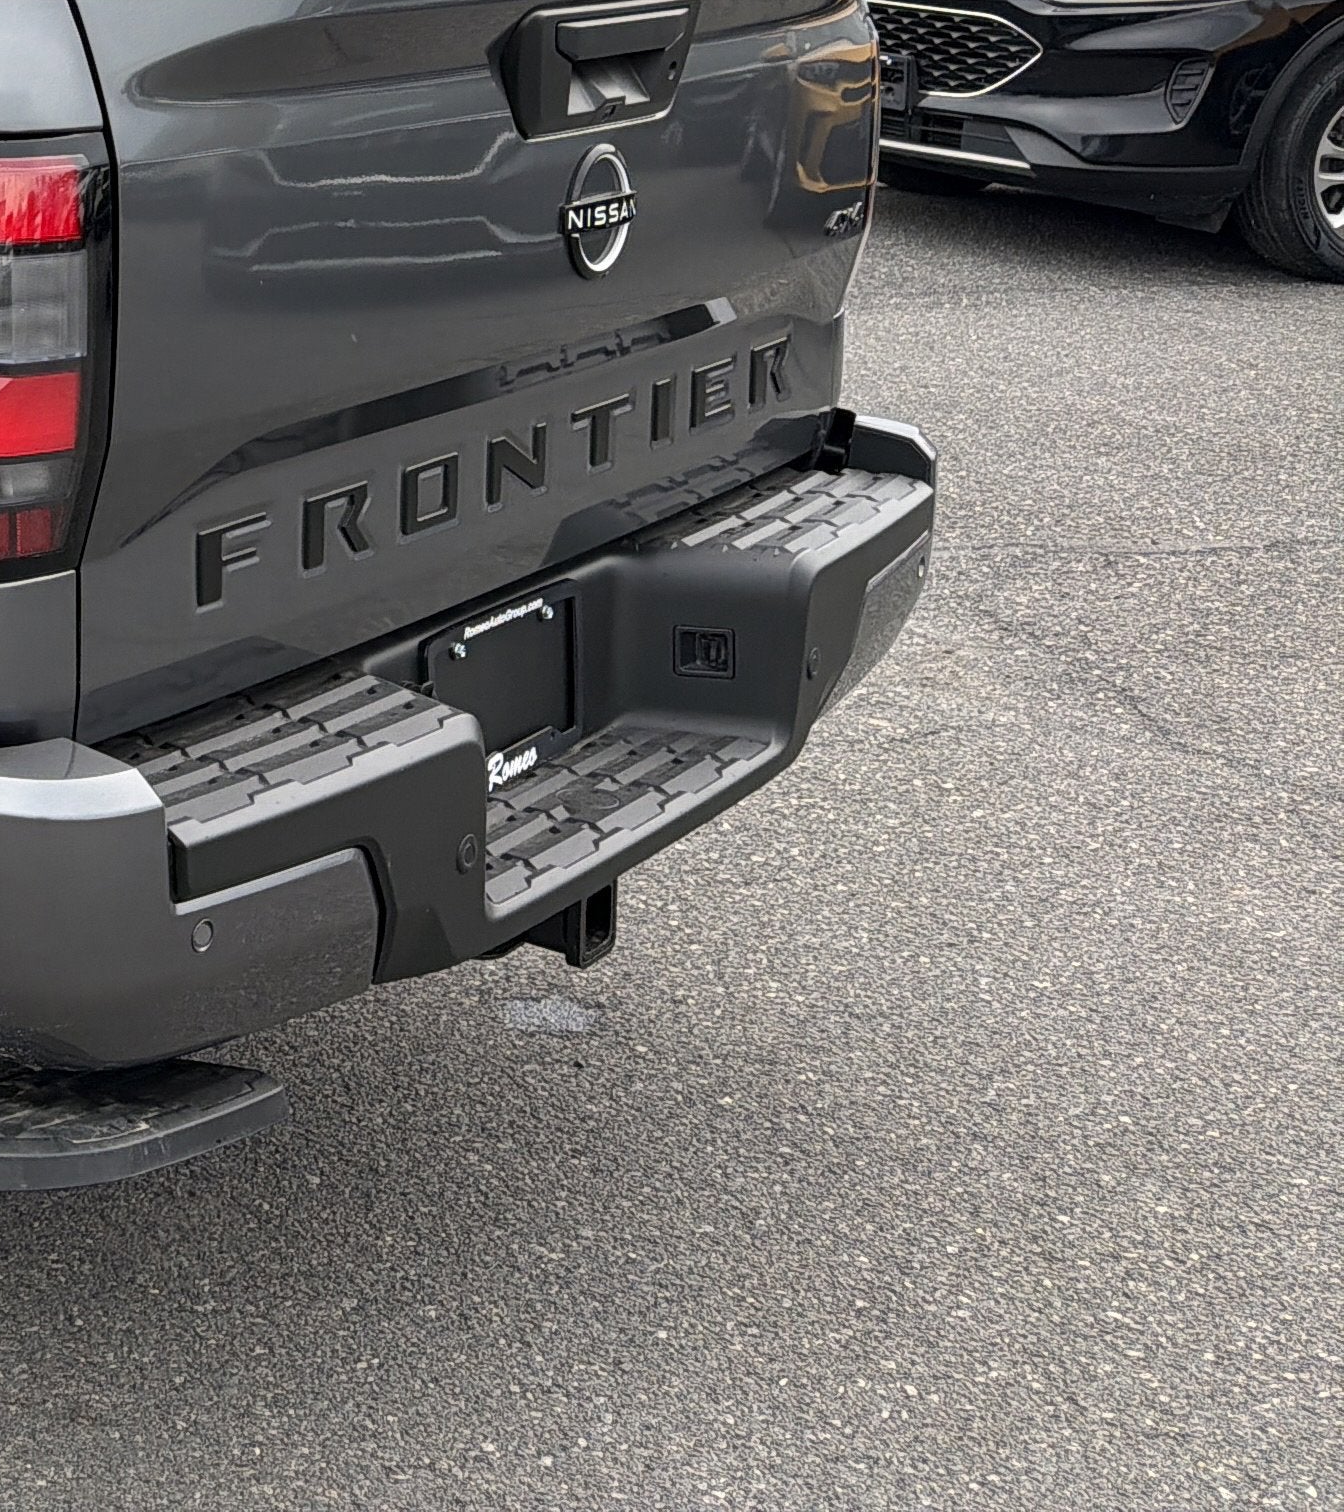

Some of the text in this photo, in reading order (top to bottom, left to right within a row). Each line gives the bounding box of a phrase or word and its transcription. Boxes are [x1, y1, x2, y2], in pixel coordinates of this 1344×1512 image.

[567, 198, 637, 230] NISSAN
[196, 336, 790, 612] FRONTIER
[487, 746, 538, 793] Romeo
